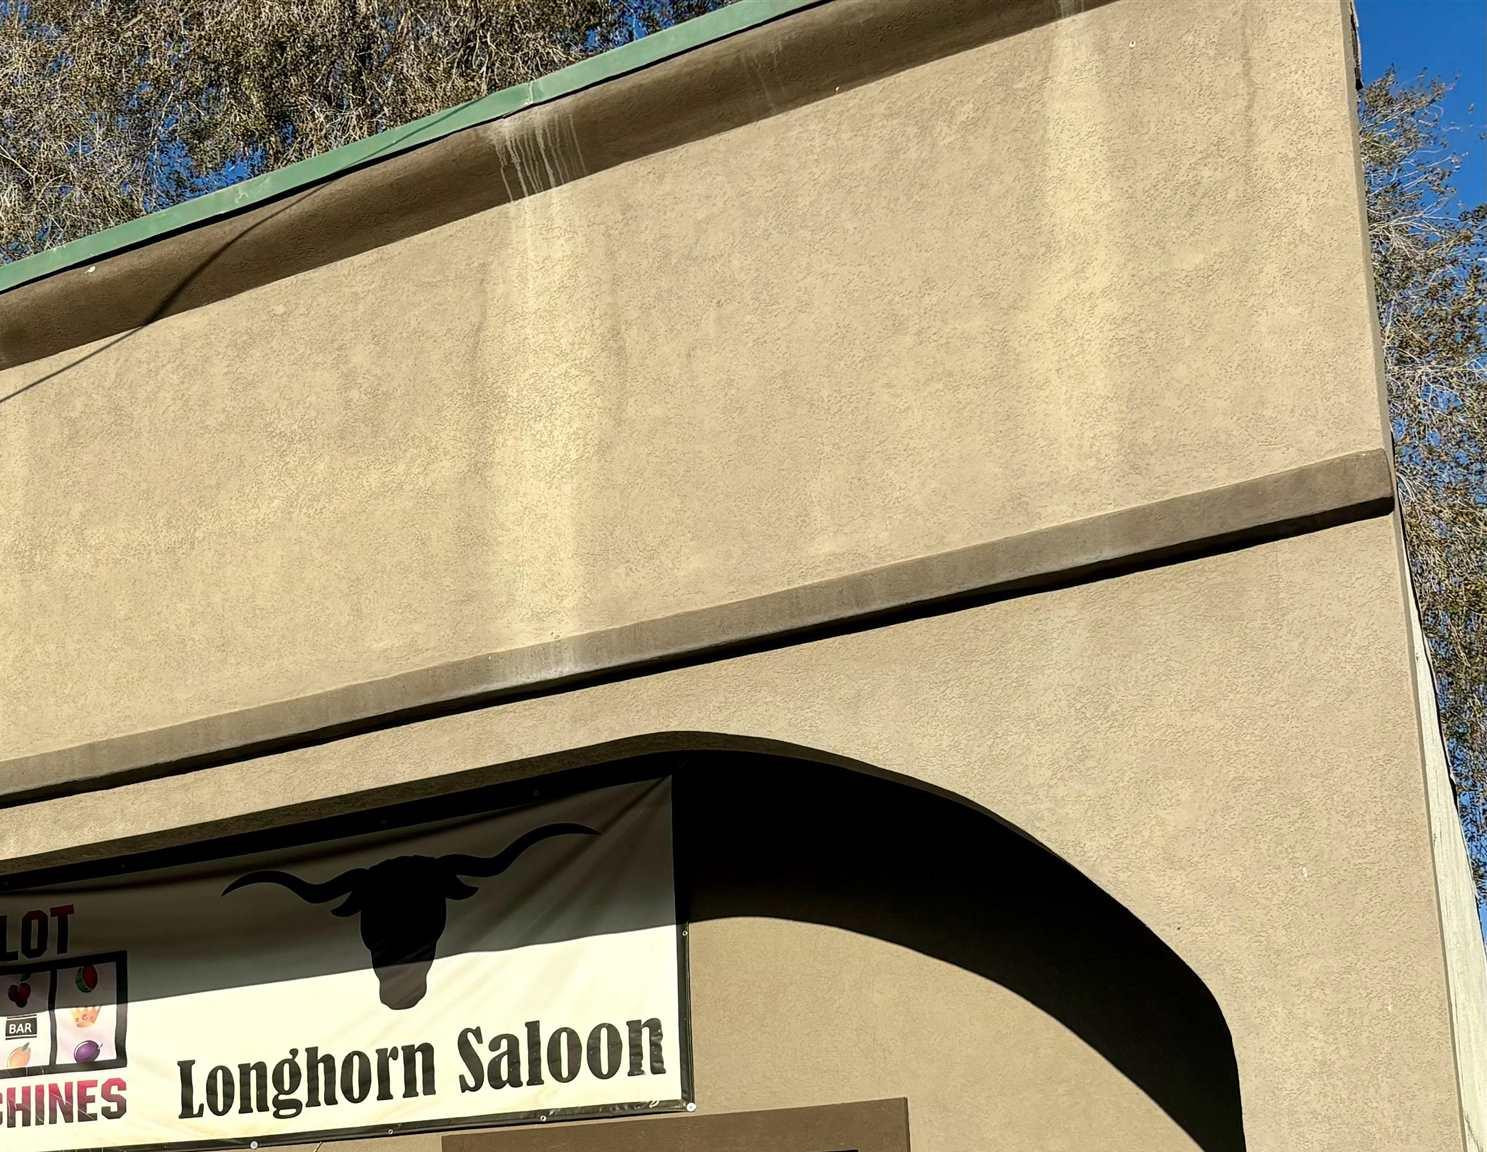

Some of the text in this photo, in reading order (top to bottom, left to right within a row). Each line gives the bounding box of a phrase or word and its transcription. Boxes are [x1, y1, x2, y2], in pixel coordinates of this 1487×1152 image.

[8, 1022, 33, 1035] BAR
[177, 1017, 667, 1120] Longhorn Saloon
